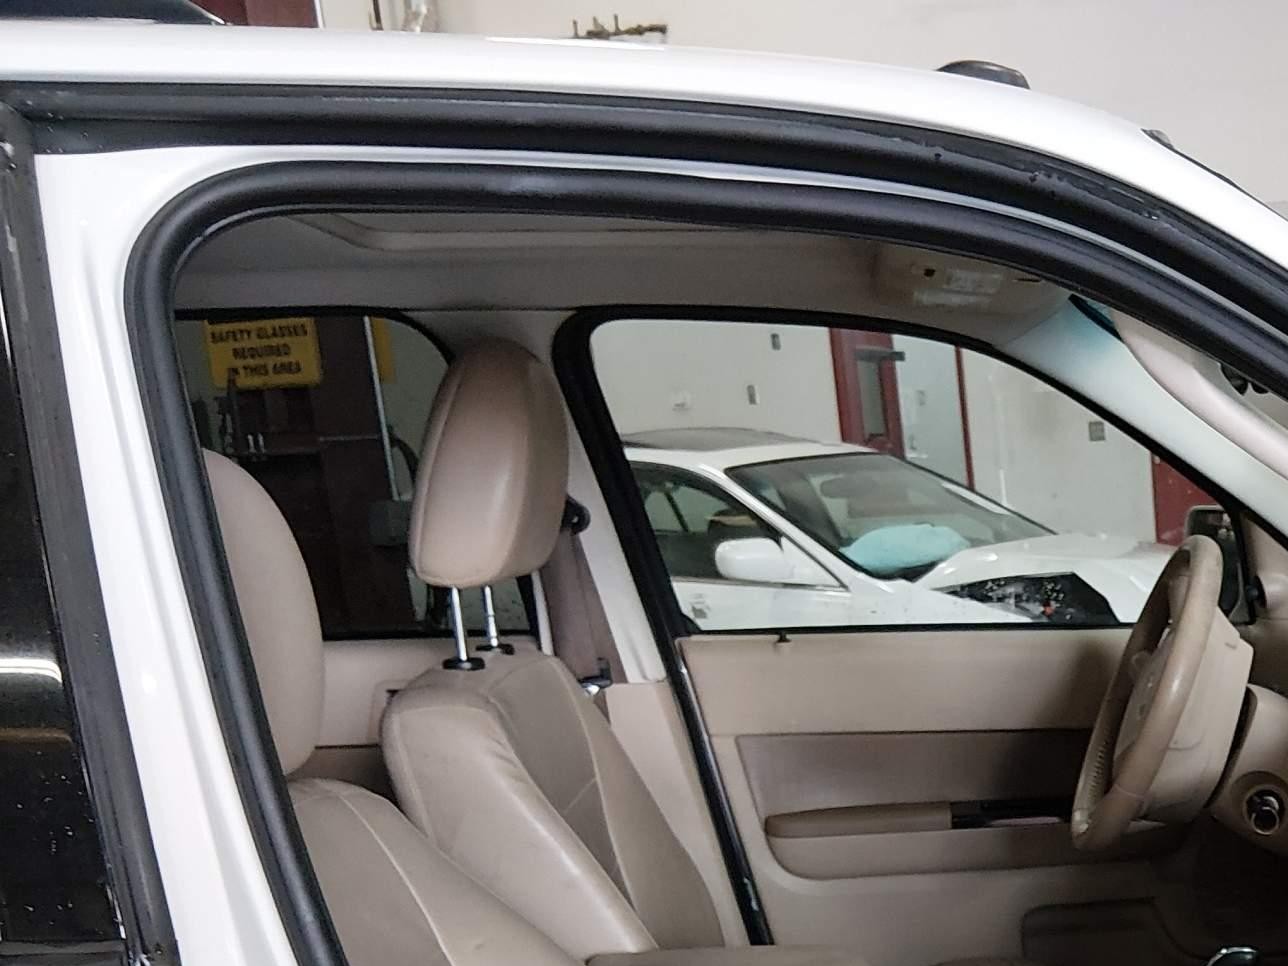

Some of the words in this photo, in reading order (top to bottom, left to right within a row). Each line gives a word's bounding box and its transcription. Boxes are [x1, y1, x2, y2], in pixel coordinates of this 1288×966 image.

[210, 328, 251, 344] SAFETY
[256, 323, 308, 340] GLASSES
[232, 343, 291, 360] REQUIRED
[243, 364, 269, 376] THIS
[272, 360, 302, 375] AREA
